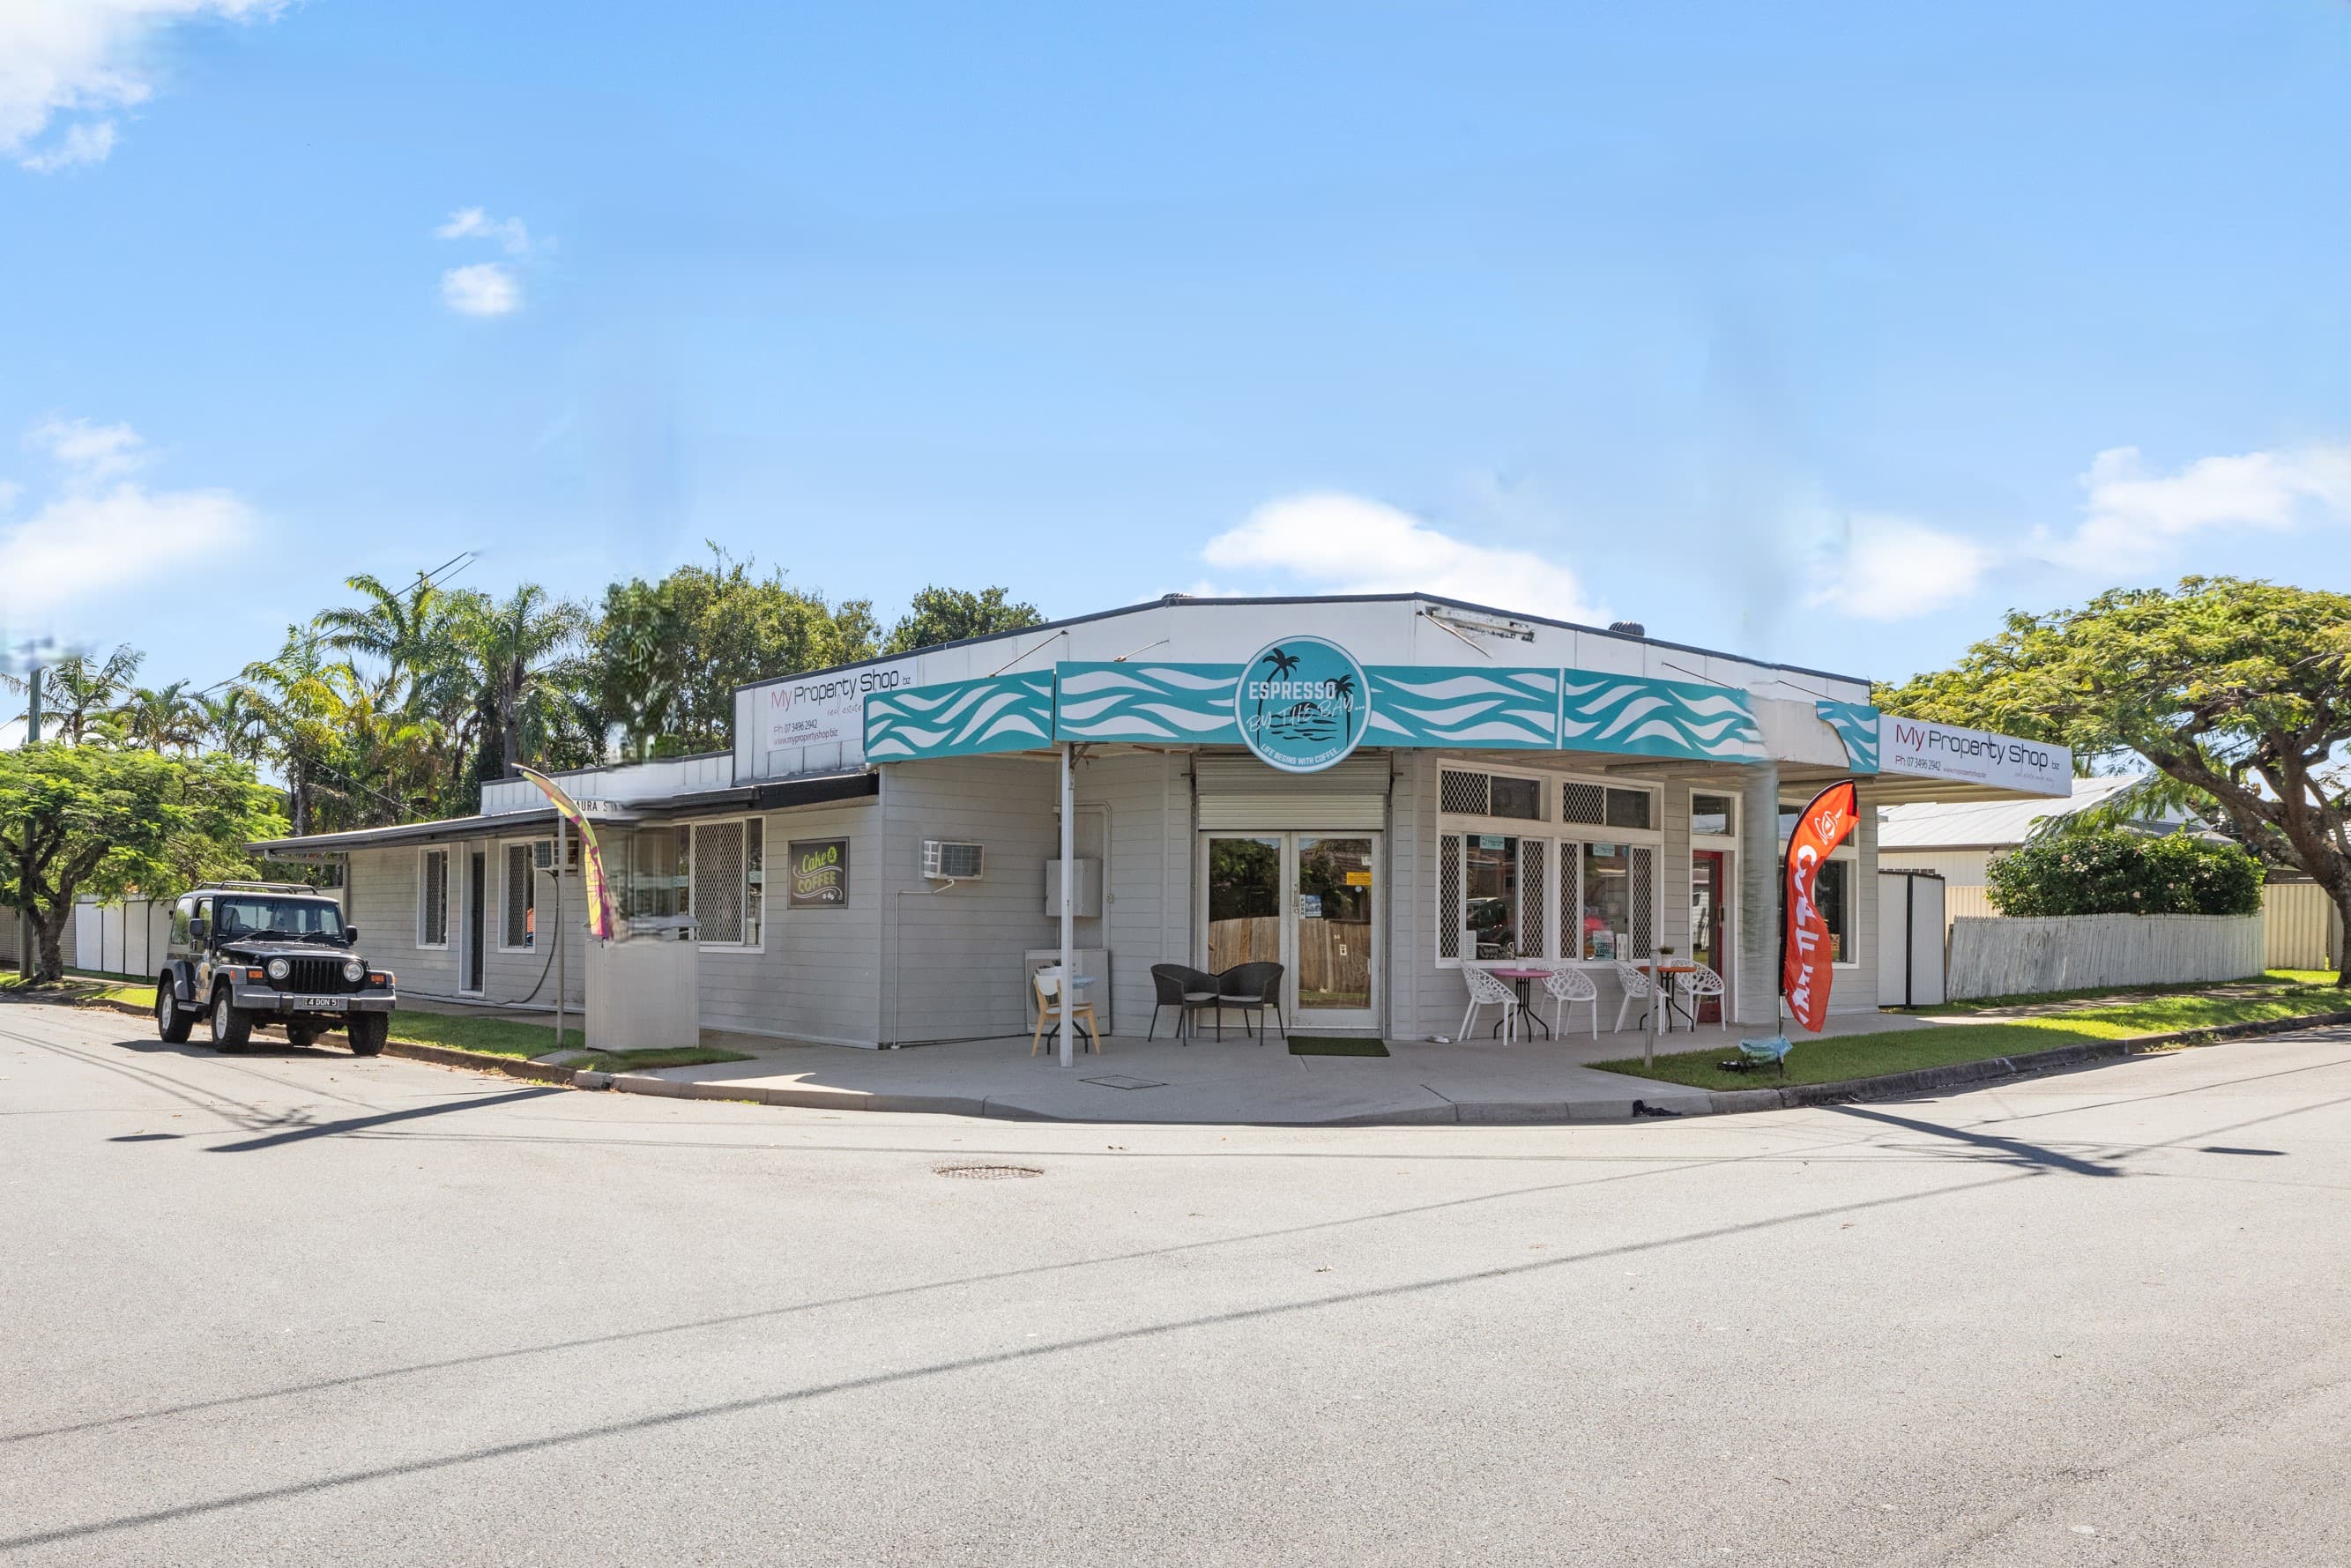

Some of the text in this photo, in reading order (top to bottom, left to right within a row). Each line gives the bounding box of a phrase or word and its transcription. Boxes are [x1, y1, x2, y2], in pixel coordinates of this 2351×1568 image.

[771, 689, 792, 712] My
[794, 677, 857, 706] Property
[860, 669, 899, 692] Shop
[1248, 681, 1336, 700] ESPRESSO
[1246, 711, 1272, 732] BY
[1274, 702, 1313, 726] THE
[1261, 743, 1274, 756] LIFE
[1274, 752, 1297, 764] BEGINS
[1298, 756, 1313, 765] WITH
[1896, 724, 1925, 752] My
[1929, 730, 2005, 765] Property
[2009, 743, 2049, 771] Shop
[1907, 756, 1914, 767] 07
[576, 800, 598, 812] AURA
[802, 851, 827, 873] Cake
[797, 871, 837, 894] COFFEE
